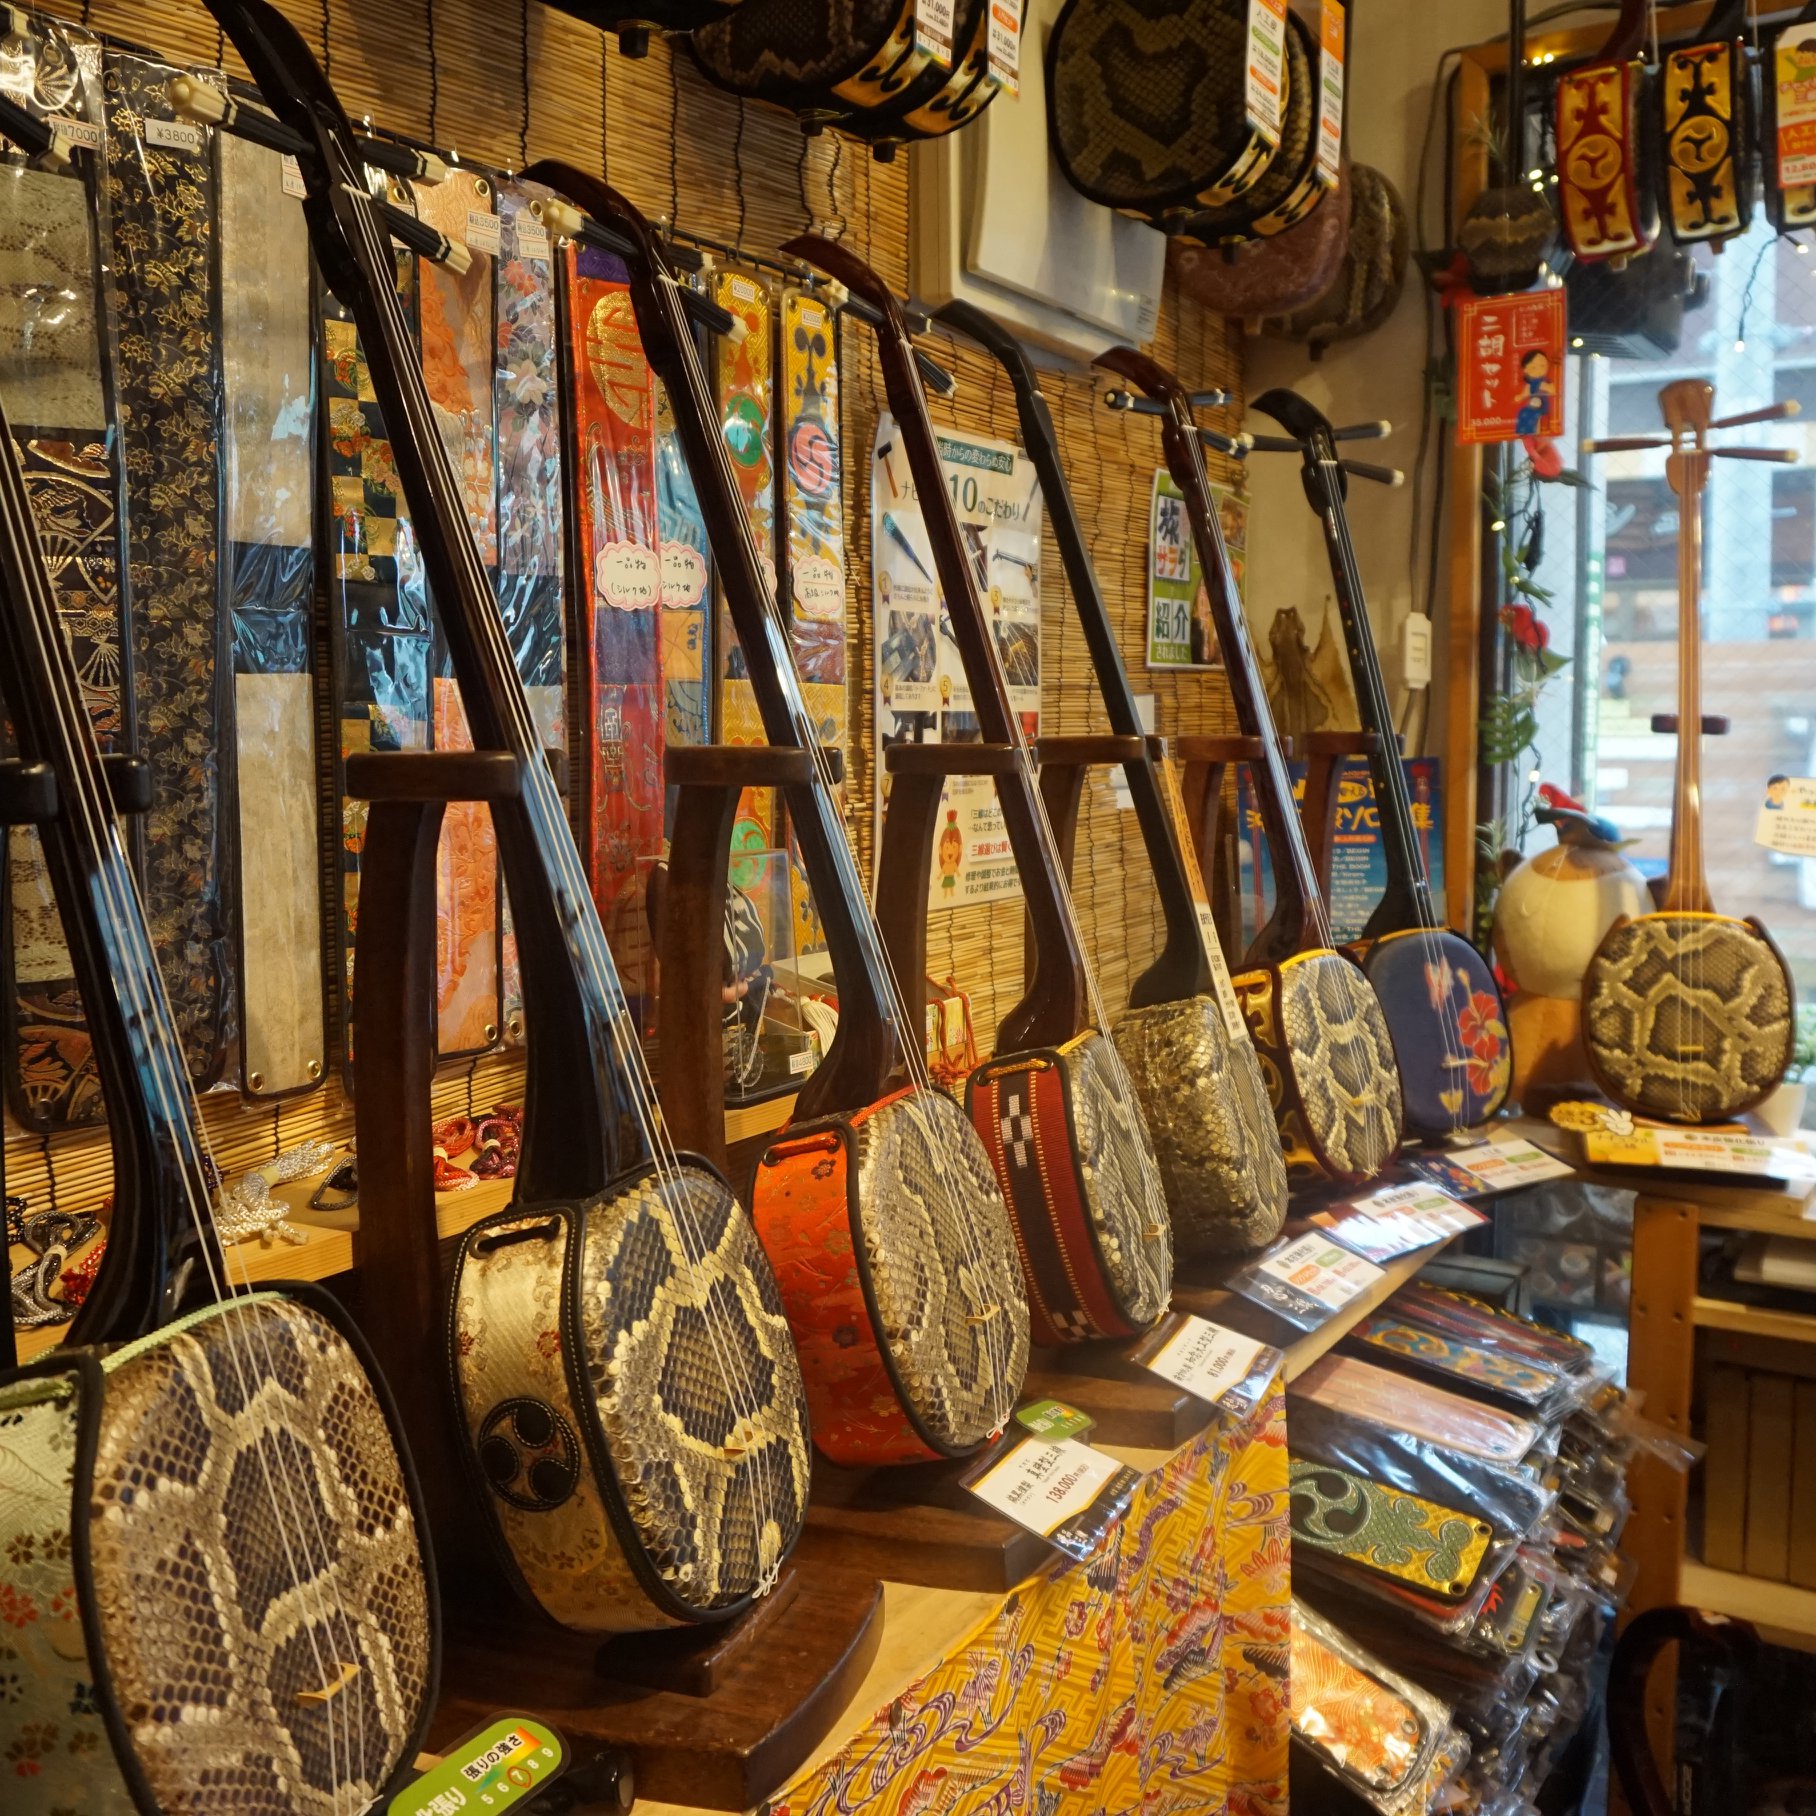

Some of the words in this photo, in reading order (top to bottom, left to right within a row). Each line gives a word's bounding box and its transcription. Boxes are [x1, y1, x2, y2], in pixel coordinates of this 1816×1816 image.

[156, 127, 196, 145] ¥3800
[1477, 314, 1505, 410] 二胡セット
[1155, 602, 1189, 643] 紹介
[464, 1734, 523, 1780] 張りの強さ
[481, 1794, 494, 1805] 5
[497, 1782, 509, 1792] 6
[511, 1770, 523, 1781] 7
[527, 1759, 539, 1769] 8
[541, 1747, 553, 1757] 9
